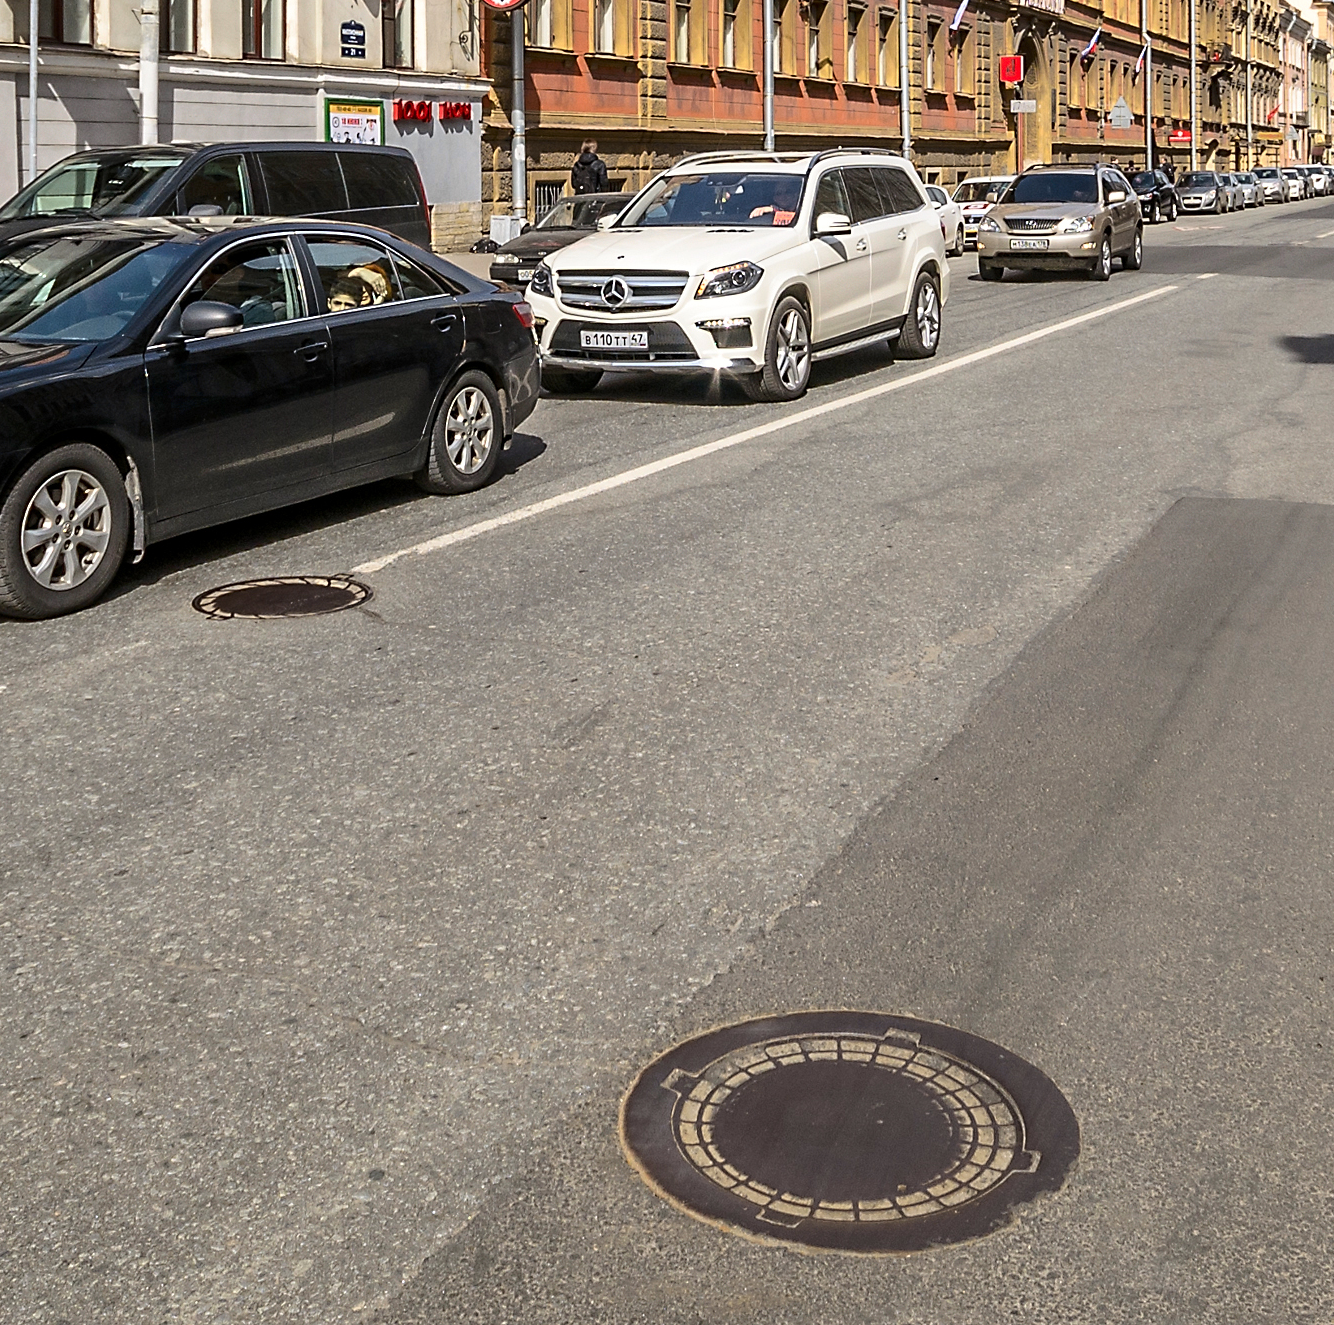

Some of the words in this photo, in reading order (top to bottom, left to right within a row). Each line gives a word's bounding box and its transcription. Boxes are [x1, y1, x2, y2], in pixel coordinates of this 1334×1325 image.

[393, 98, 432, 123] 1001
[585, 333, 628, 346] В110ТТ
[631, 333, 643, 344] 47
